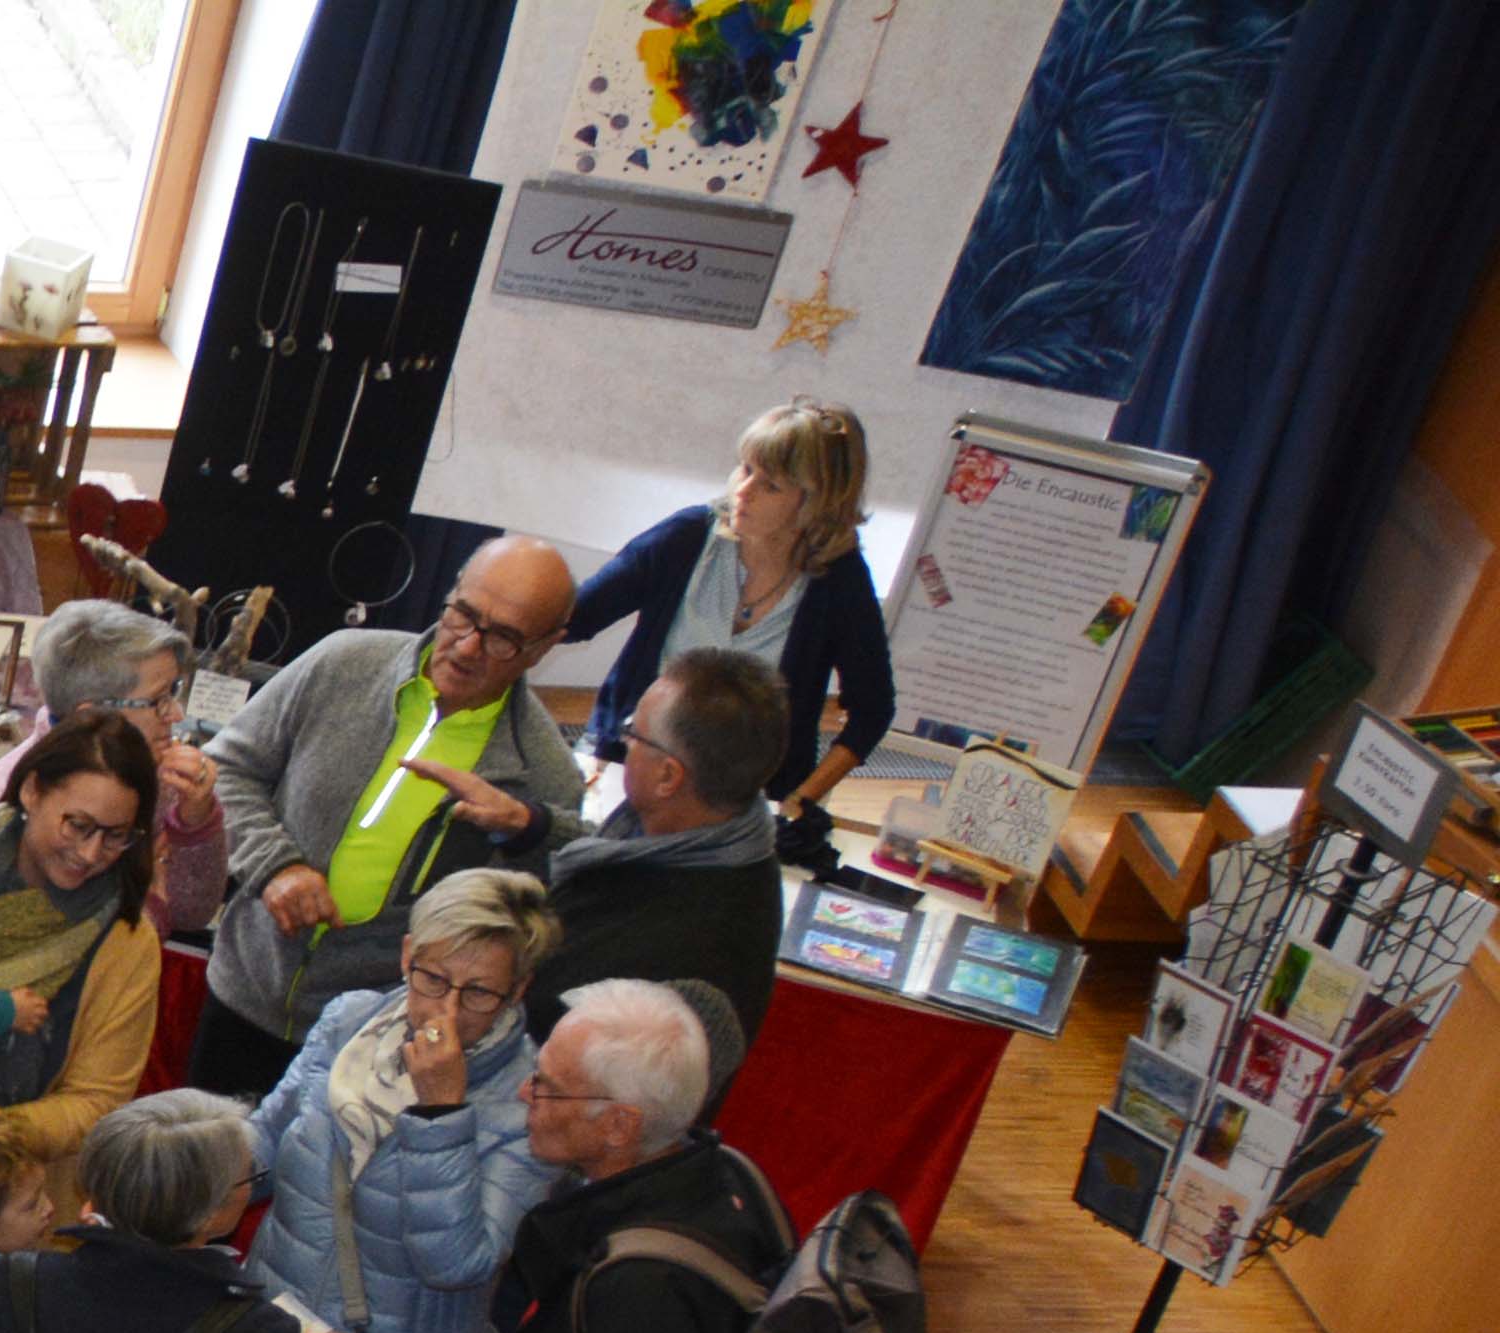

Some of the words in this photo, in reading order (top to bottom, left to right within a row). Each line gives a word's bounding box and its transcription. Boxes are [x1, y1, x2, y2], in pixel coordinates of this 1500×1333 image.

[532, 208, 698, 271] Homes
[1003, 469, 1031, 490] Die
[1036, 472, 1121, 511] Encaustic
